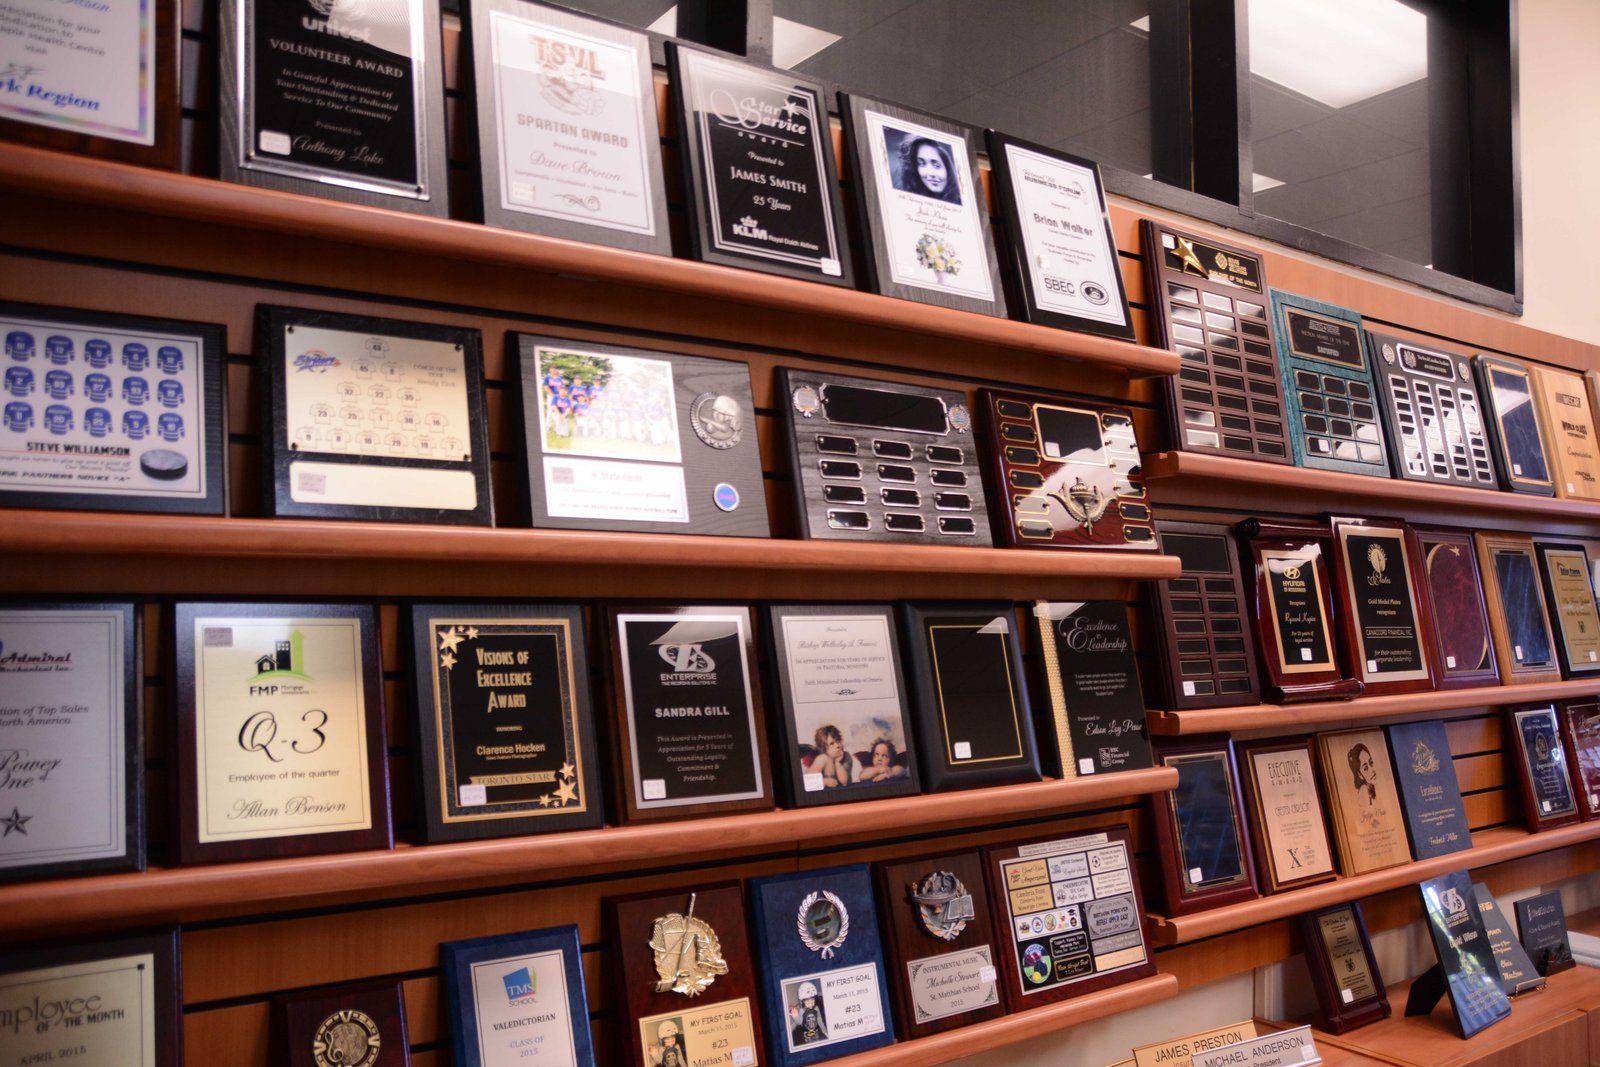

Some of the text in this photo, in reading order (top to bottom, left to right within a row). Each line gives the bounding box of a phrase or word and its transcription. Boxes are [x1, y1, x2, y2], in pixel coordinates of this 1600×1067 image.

[269, 37, 404, 79] VOLUNTEER AWARD
[293, 69, 328, 85] Grateful
[329, 79, 379, 96] Appreciation
[27, 83, 101, 111] Region
[297, 83, 347, 102] Outstanding
[358, 96, 399, 112] Dedicated
[345, 104, 393, 122] Community
[516, 112, 629, 149] SPARTAN AWARD
[292, 135, 385, 166] Anthony Lake
[529, 150, 569, 172] Dave
[572, 158, 624, 183] Brown
[730, 165, 807, 194] JAMES SMITH
[732, 223, 768, 241] KLM
[1034, 212, 1059, 228] Brian
[1061, 219, 1093, 237] Walker
[1044, 277, 1076, 295] SBEC
[27, 441, 131, 456] STEVE WILLIAMSON
[1087, 638, 1128, 652] Leadership
[0, 652, 72, 664] Admiral
[660, 673, 718, 681] ENTERPRISE
[249, 685, 279, 697] FMP
[23, 705, 36, 718] of
[37, 705, 58, 718] Top
[60, 705, 89, 714] Sales
[655, 706, 730, 718] SANDRA GILL
[0, 716, 72, 727] orth America
[476, 742, 546, 756] Clarence Hocken
[666, 755, 704, 763] Outstanding
[228, 768, 342, 784] Employee of the quarter
[1267, 760, 1301, 779] EXECUTIVE
[475, 773, 550, 786] TORONTO STAR
[226, 795, 349, 821] Allan Benson
[922, 956, 979, 976] INSTRUMENTAL MUSIC
[826, 974, 872, 988] MY FIRST GOAL
[925, 970, 980, 990] Michelle Stewart
[507, 984, 534, 997] TMS
[833, 987, 869, 1001] March 2015
[938, 987, 963, 1000] Matthias
[963, 983, 980, 995] School
[509, 997, 536, 1007] SCHOOL
[845, 1003, 862, 1014] #23
[951, 998, 964, 1008] 2015
[36, 1008, 124, 1034] OF THE MONTH
[493, 1013, 556, 1031] VALEDICTORIAN
[690, 1010, 743, 1028] MY FIRST GOAL
[833, 1017, 864, 1031] Matias M
[510, 1035, 545, 1048] CLASS OF
[712, 1038, 729, 1050] #23
[1155, 1031, 1243, 1063] JAMES PRESTON
[20, 1045, 87, 1067] APRIL 2015
[519, 1048, 538, 1058] 2015
[1204, 1036, 1304, 1067] MICHAEL ANDERSON
[693, 1055, 723, 1067] Matias
[1253, 1057, 1281, 1067] President
